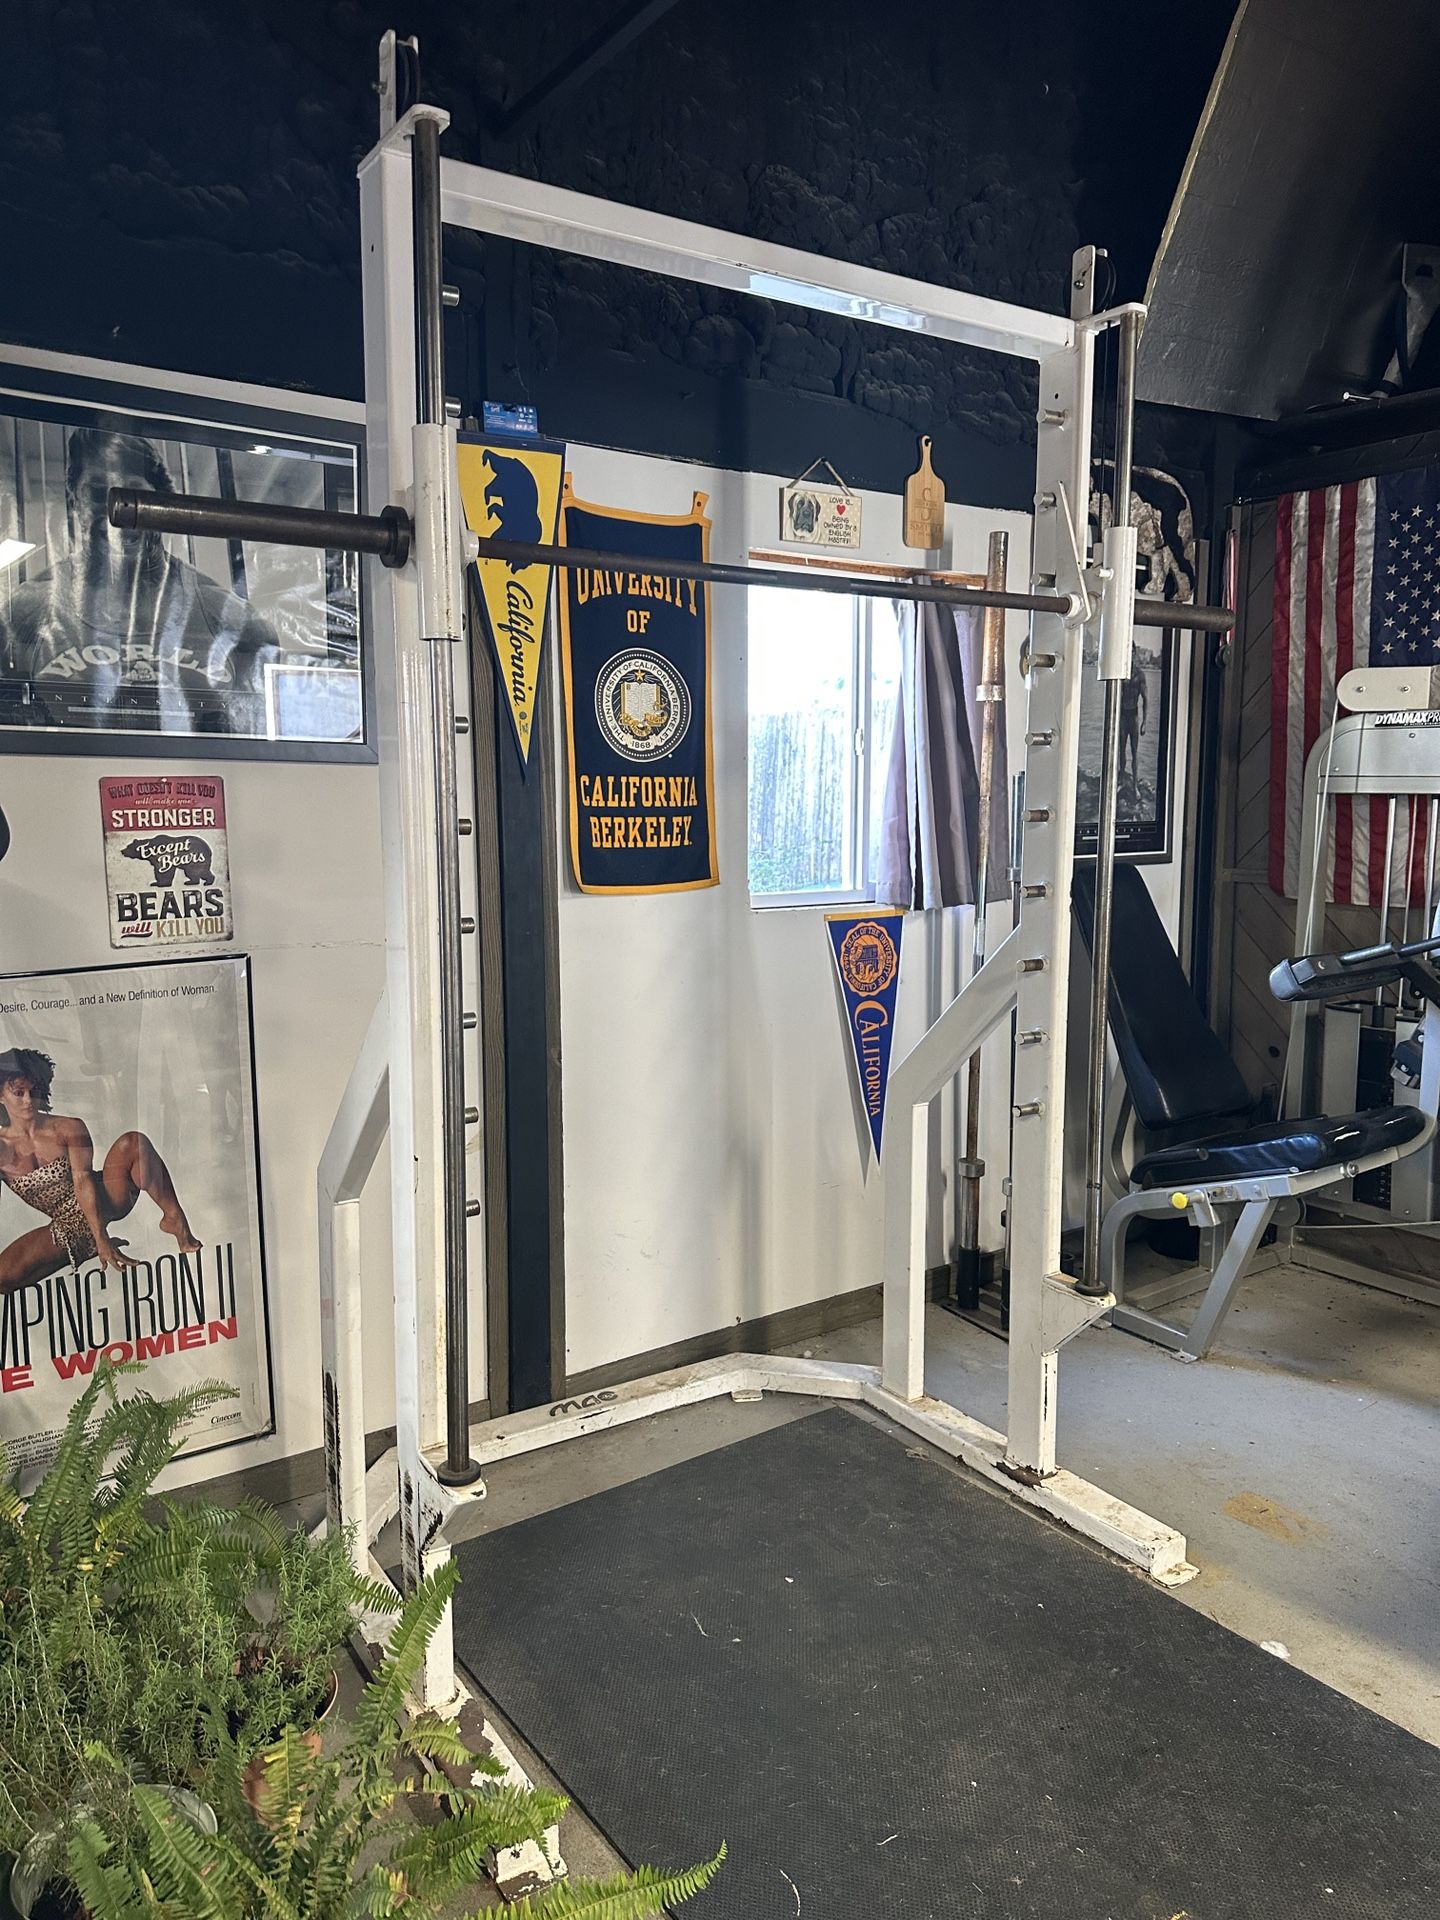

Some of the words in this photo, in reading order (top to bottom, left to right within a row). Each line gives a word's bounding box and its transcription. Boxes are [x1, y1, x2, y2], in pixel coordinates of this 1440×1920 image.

[576, 567, 697, 616] UNIVERSITY
[627, 609, 650, 633] OF
[497, 580, 535, 706] California
[39, 644, 232, 683] WORLD
[623, 662, 633, 671] OF
[633, 660, 676, 695] CALIFORNIA
[32, 693, 227, 709] INTENSITY
[604, 668, 622, 725] UNIVERSITY
[660, 697, 679, 742] BERKELEY
[1375, 711, 1440, 725] DYNAMAXPR
[611, 724, 625, 742] THE
[108, 784, 133, 799] WHAT
[176, 783, 197, 796] KILL
[198, 784, 216, 798] YOU
[580, 774, 698, 808] CALIFORNIA
[111, 808, 215, 828] STRONGER
[590, 816, 692, 848] BERKELEY
[136, 839, 191, 859] Except
[158, 851, 206, 873] Bears
[116, 888, 224, 922] BEARS
[121, 922, 152, 934] will
[156, 920, 193, 938] KILL
[196, 917, 225, 935] YOU
[31, 998, 78, 1011] Courage...
[79, 995, 96, 1006] and
[98, 996, 105, 1004] a
[107, 992, 126, 1003] New
[128, 987, 169, 1001] Definition
[170, 986, 180, 997] of
[855, 1000, 889, 1117] CALIFORNIA
[121, 1249, 206, 1342] IRON
[215, 1243, 236, 1320] II
[51, 1316, 238, 1381] WOMEN
[210, 1411, 241, 1425] Cinecom
